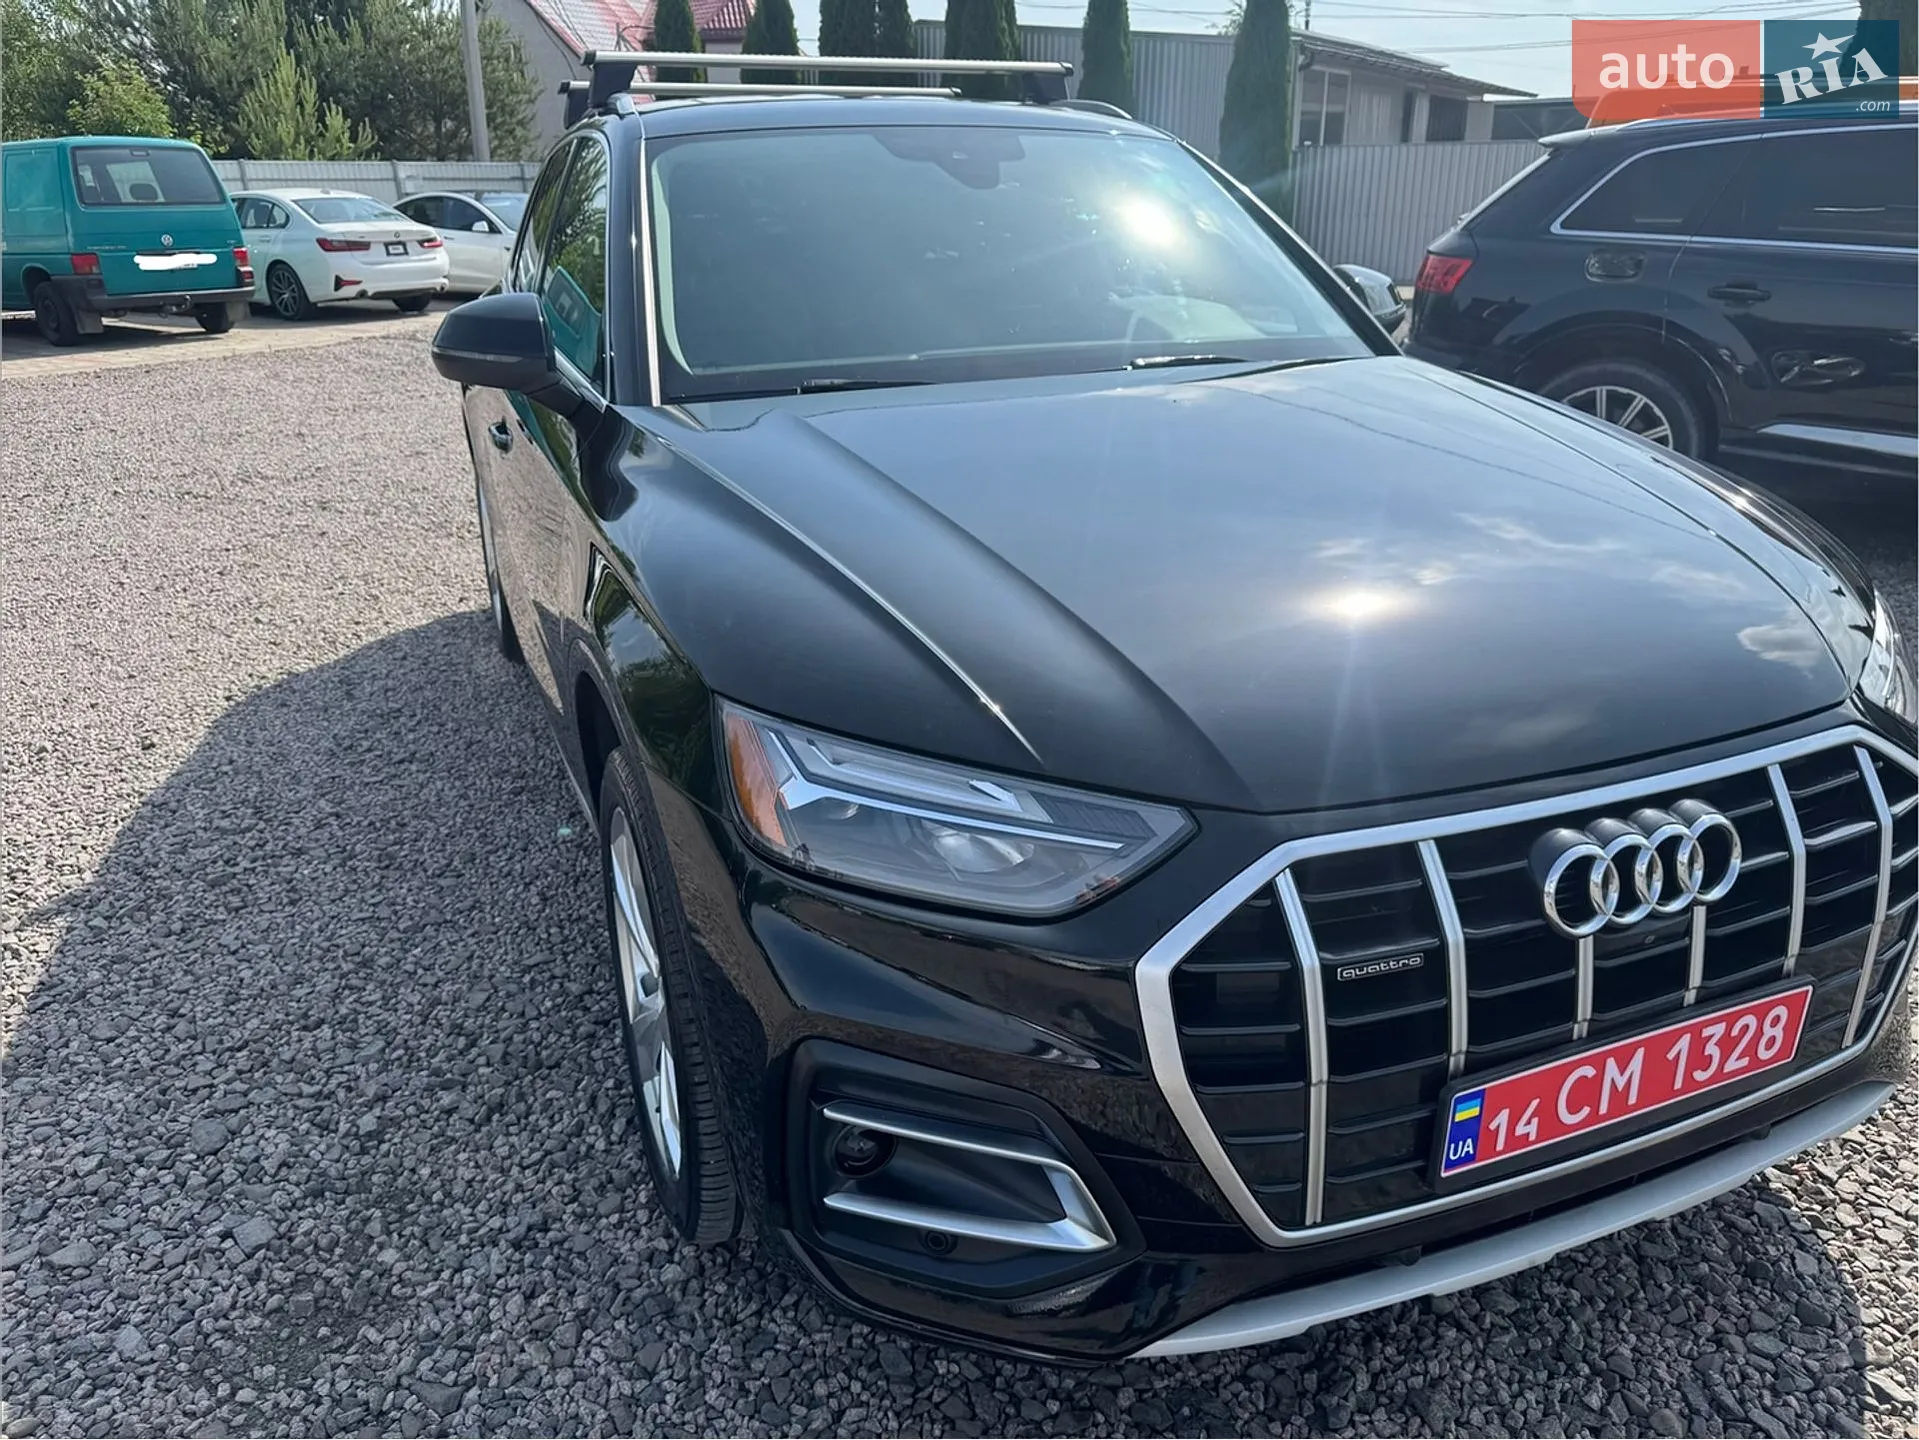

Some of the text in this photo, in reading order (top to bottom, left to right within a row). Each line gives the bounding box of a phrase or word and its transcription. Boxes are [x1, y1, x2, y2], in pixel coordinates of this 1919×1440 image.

[1342, 957, 1421, 979] quattro
[1489, 1004, 1789, 1152] 14 CM 1328
[1448, 1137, 1474, 1161] UA
